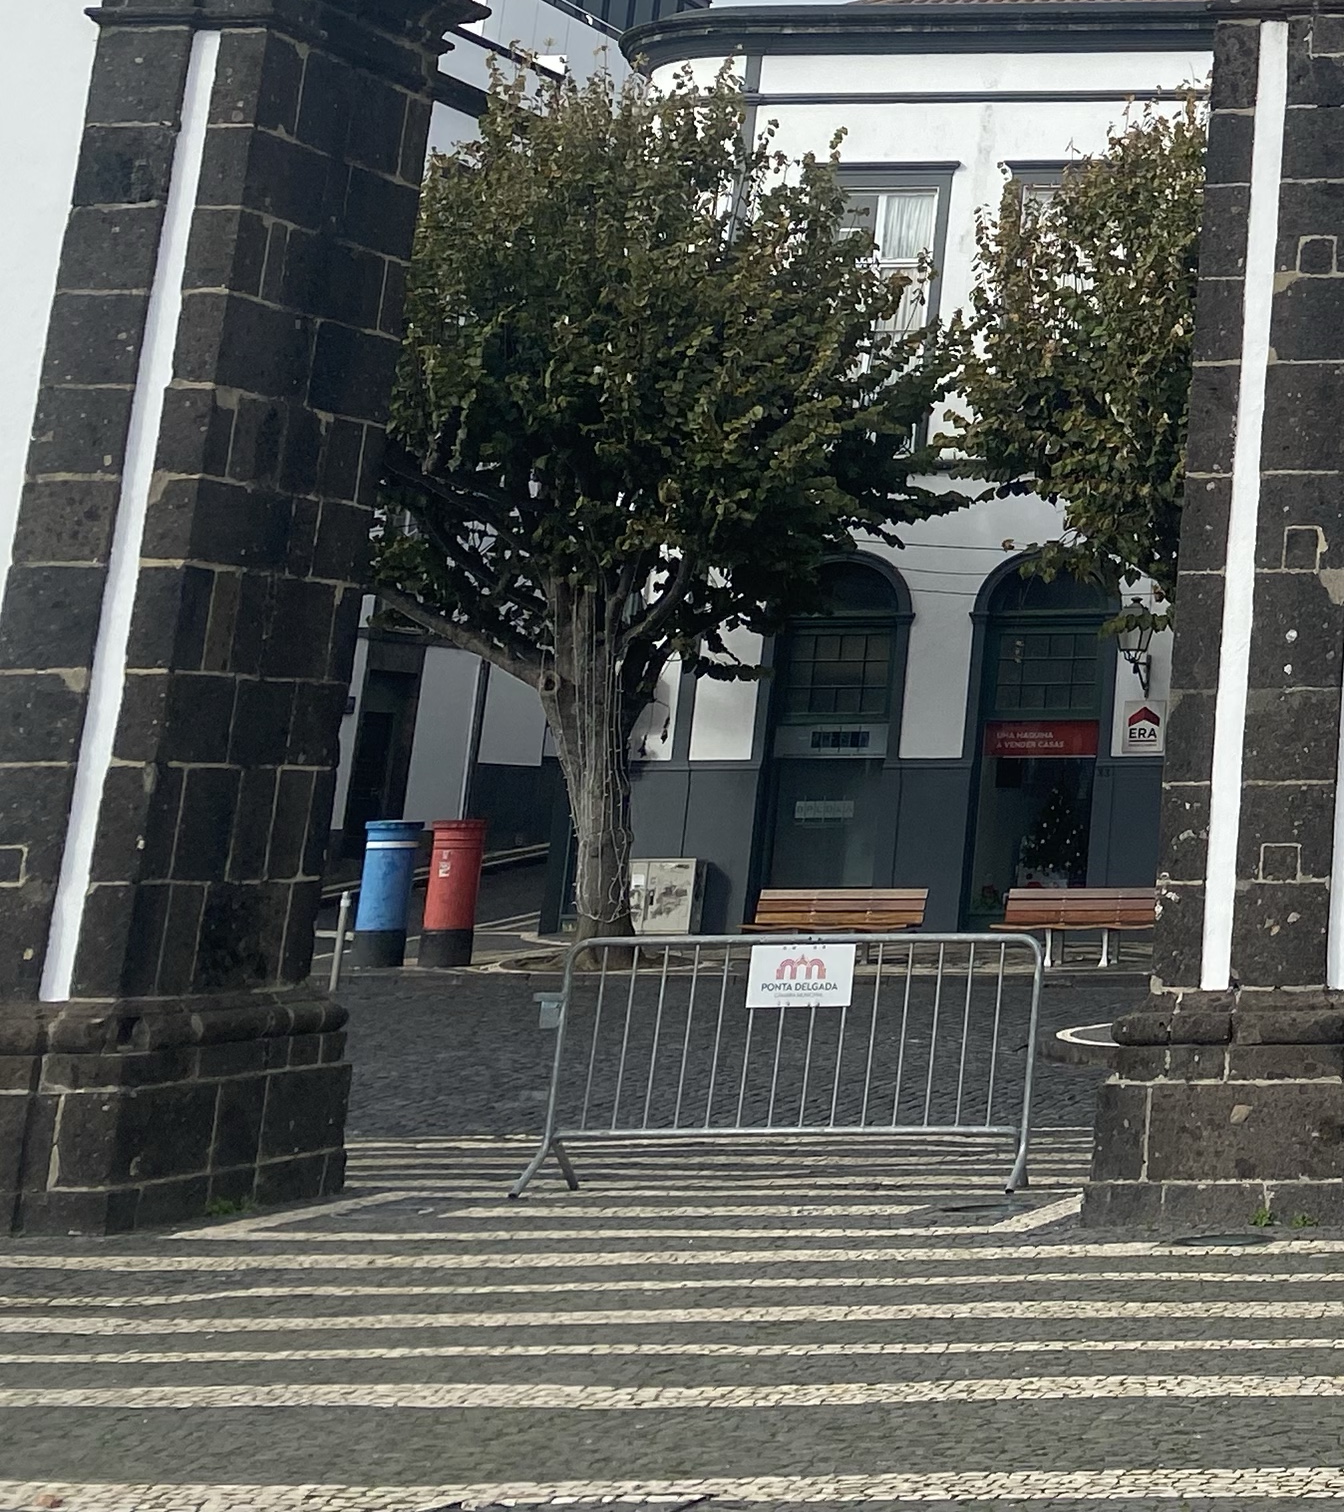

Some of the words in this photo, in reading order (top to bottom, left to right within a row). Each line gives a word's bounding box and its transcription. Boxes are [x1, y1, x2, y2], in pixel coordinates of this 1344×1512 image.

[1129, 727, 1157, 739] ERA
[1037, 740, 1065, 748] CASAS
[761, 982, 793, 992] PONTA
[794, 982, 838, 991] DELGADA
